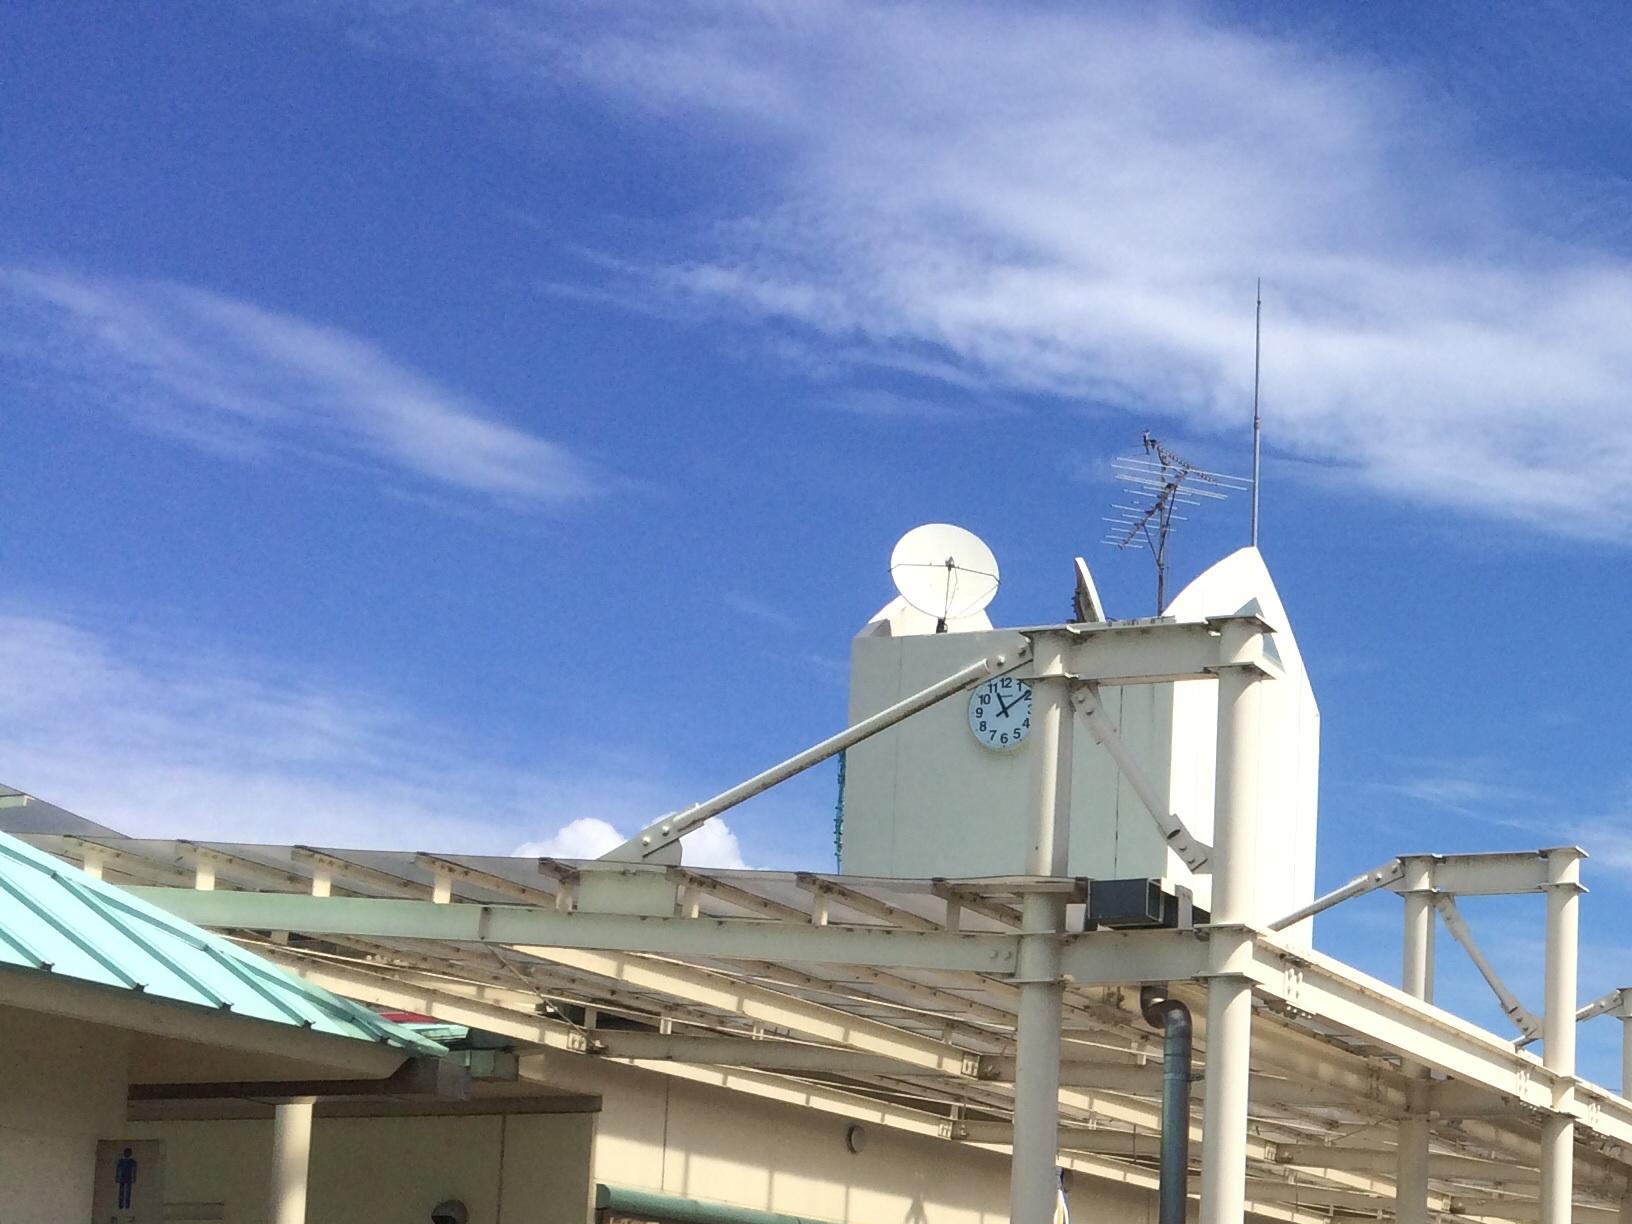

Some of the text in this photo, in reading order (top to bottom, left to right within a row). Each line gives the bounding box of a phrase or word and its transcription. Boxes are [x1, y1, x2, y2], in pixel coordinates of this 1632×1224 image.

[987, 683, 998, 693] 11
[1000, 677, 1012, 688] 12
[979, 694, 991, 705] 10
[975, 707, 983, 718] 9
[979, 721, 987, 732] 8
[1022, 718, 1030, 729] 4
[989, 730, 997, 741] 7
[1000, 733, 1008, 744] 6
[1013, 728, 1021, 739] 5
